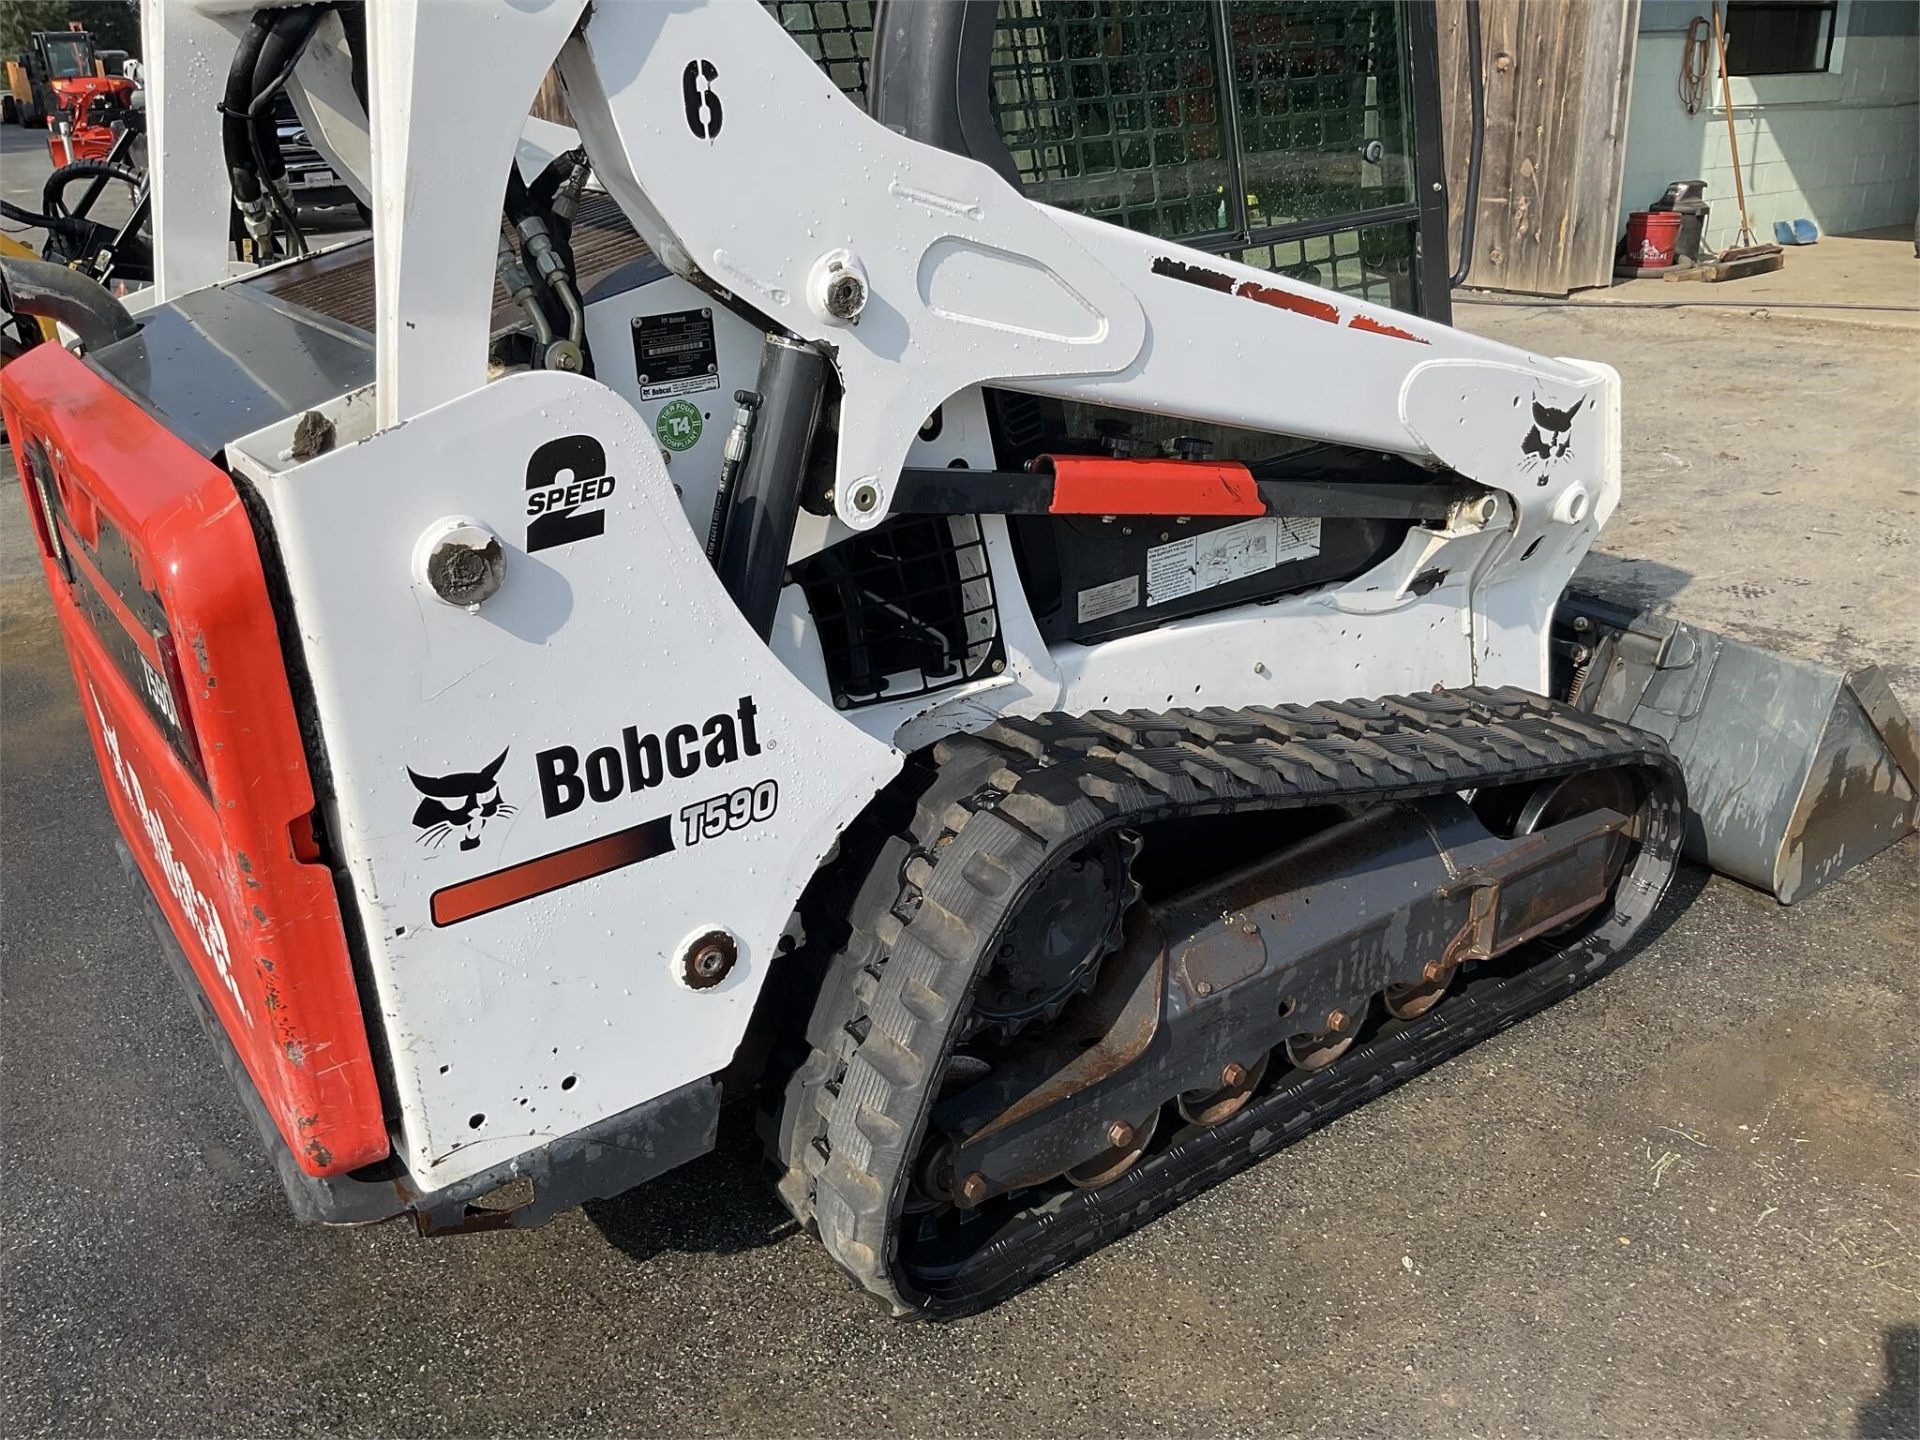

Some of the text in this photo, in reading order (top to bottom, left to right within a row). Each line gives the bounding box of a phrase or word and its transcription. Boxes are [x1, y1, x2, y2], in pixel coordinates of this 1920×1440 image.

[683, 59, 723, 140] 6
[651, 387, 672, 396] Bobcat
[676, 403, 694, 416] FOUR
[663, 431, 698, 448] COMPLIANT
[669, 416, 691, 436] T4
[525, 434, 607, 554] 2
[527, 476, 616, 516] SPEED
[536, 695, 762, 820] Bobcat
[680, 778, 779, 847] T590
